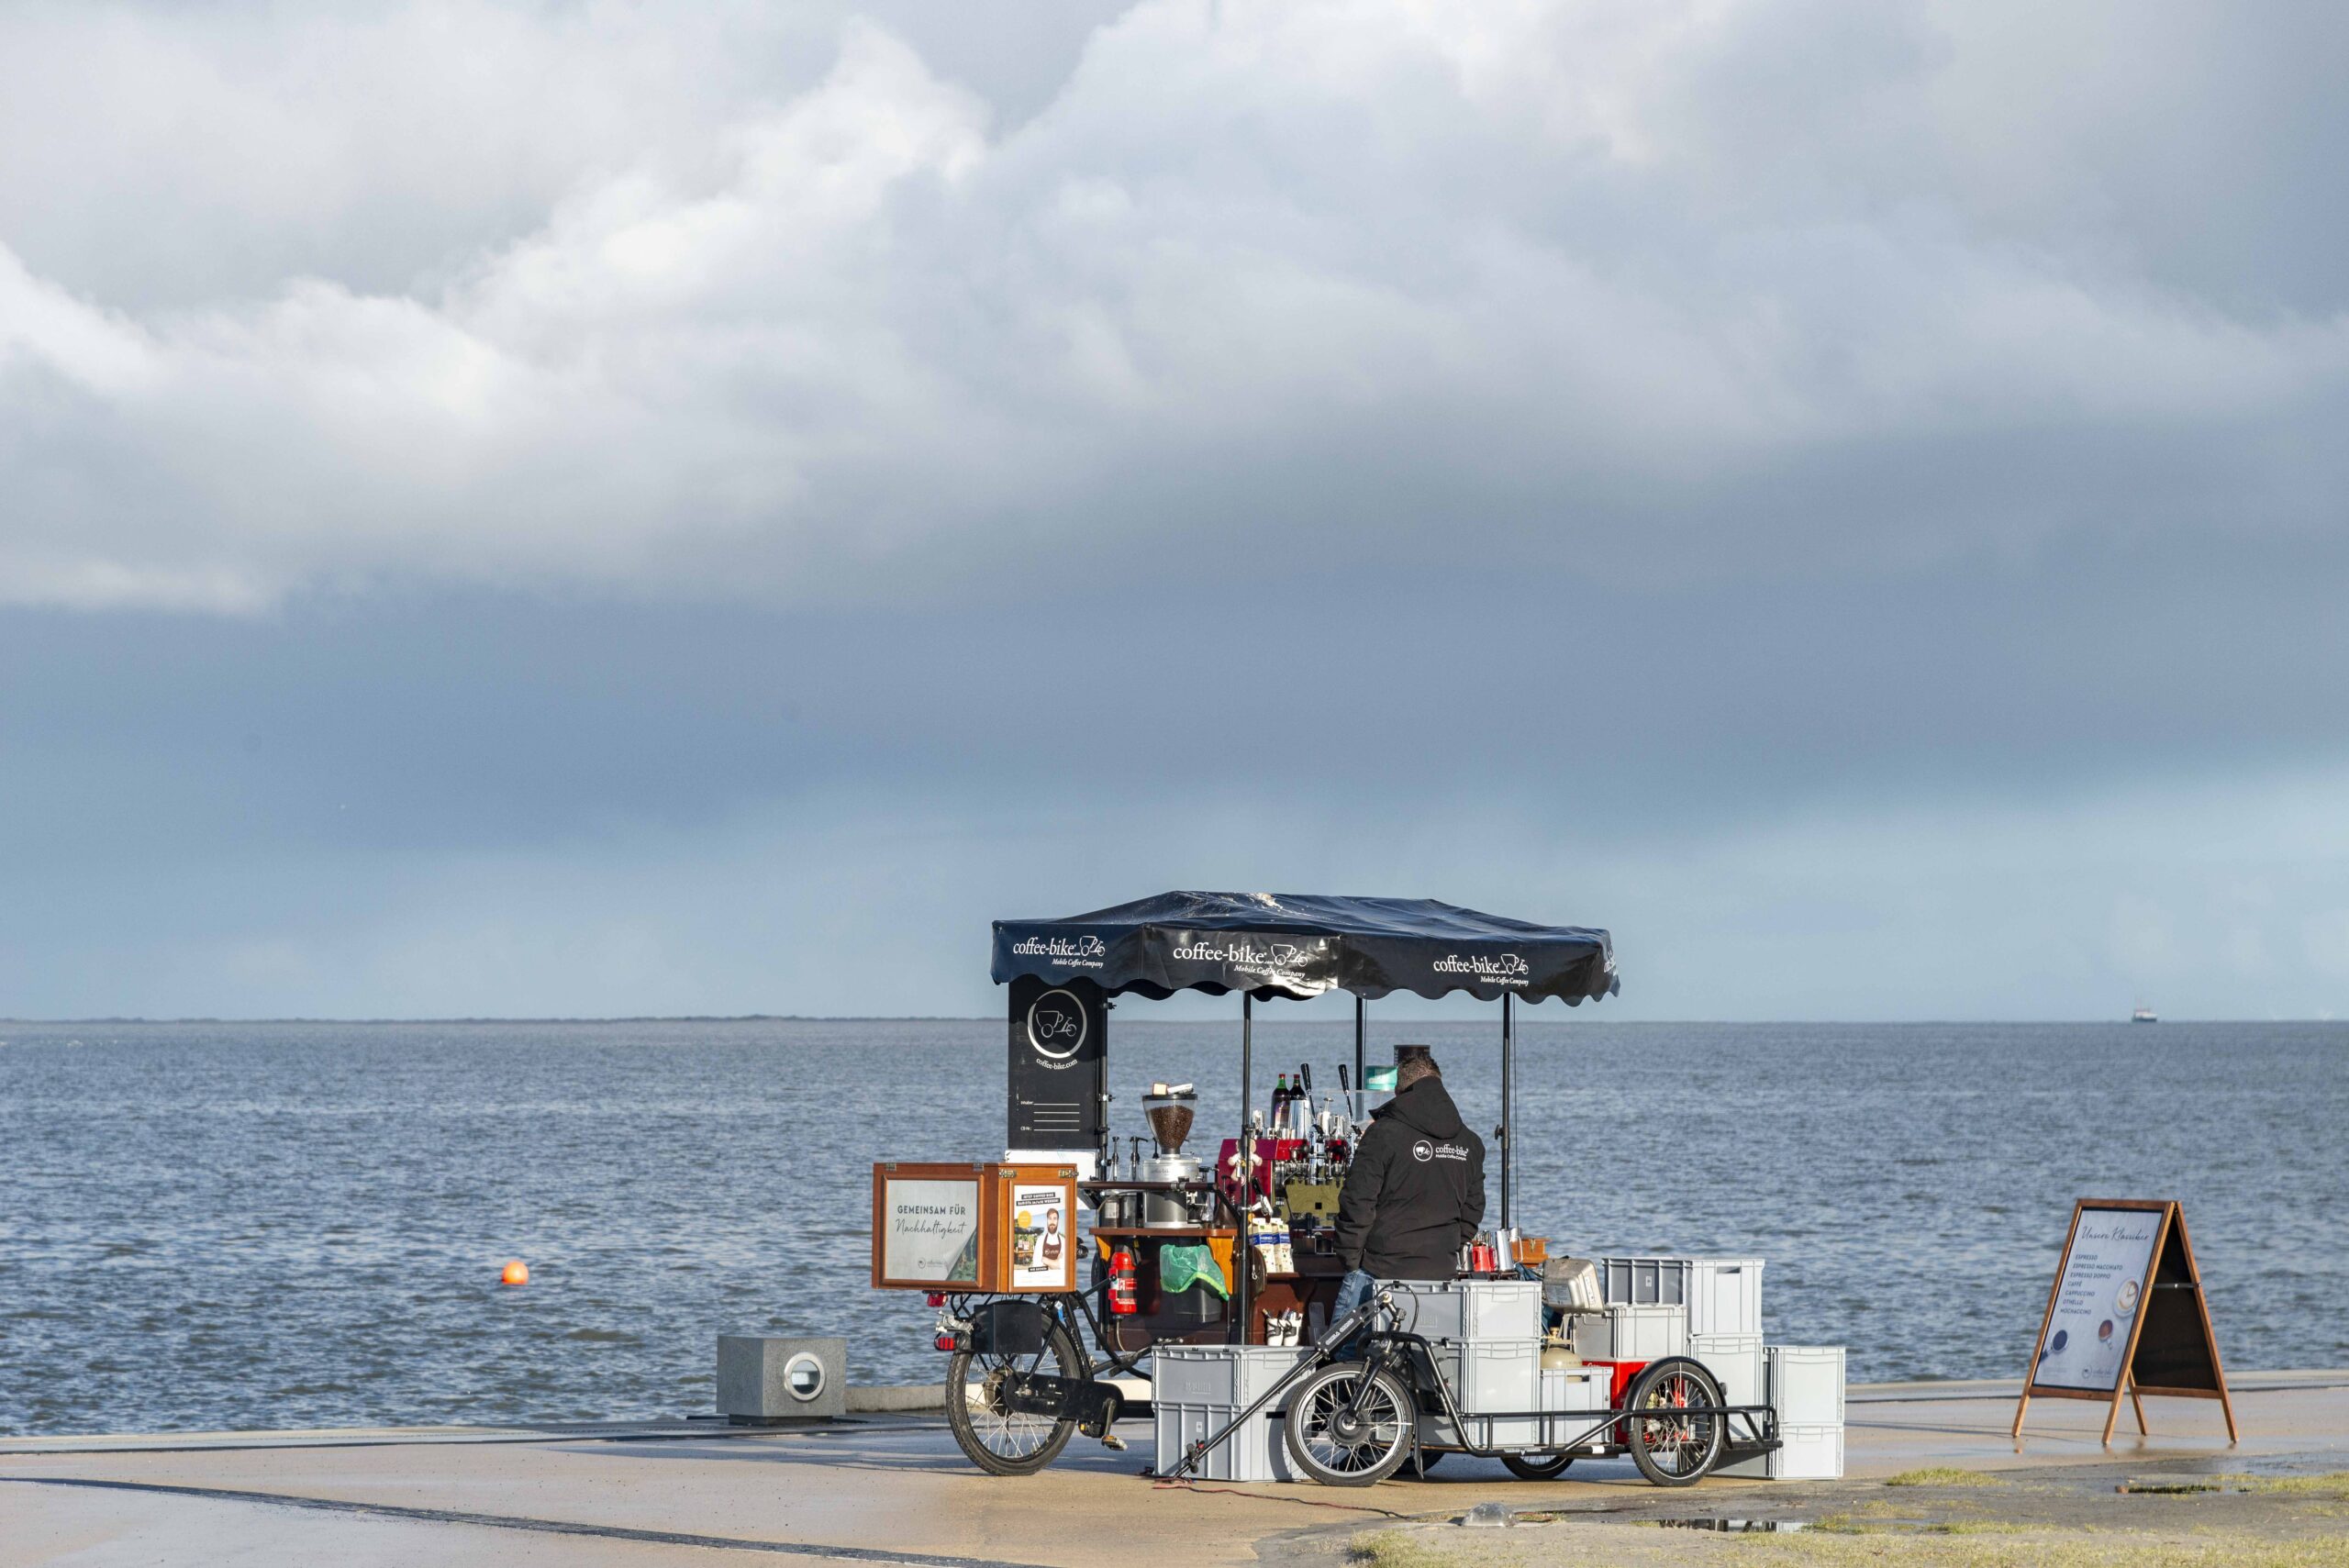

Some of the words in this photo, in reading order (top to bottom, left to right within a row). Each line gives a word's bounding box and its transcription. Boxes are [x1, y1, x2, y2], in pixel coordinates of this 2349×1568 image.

[1052, 958, 1068, 966] Mobile
[1067, 959, 1082, 968] Coffee
[1082, 960, 1104, 969] Company
[1256, 966, 1276, 976] Coffee
[1276, 968, 1306, 979] Company
[1496, 976, 1509, 985] Coffee
[1508, 978, 1529, 987] Company
[1036, 1058, 1078, 1070] coffee-bike.com
[896, 1205, 947, 1215] GEMEINSAM
[949, 1203, 966, 1216] FÜR
[896, 1218, 967, 1240] Nachhaltigkeit
[2081, 1226, 2110, 1240] Unsere
[2110, 1225, 2150, 1241] Klassiker
